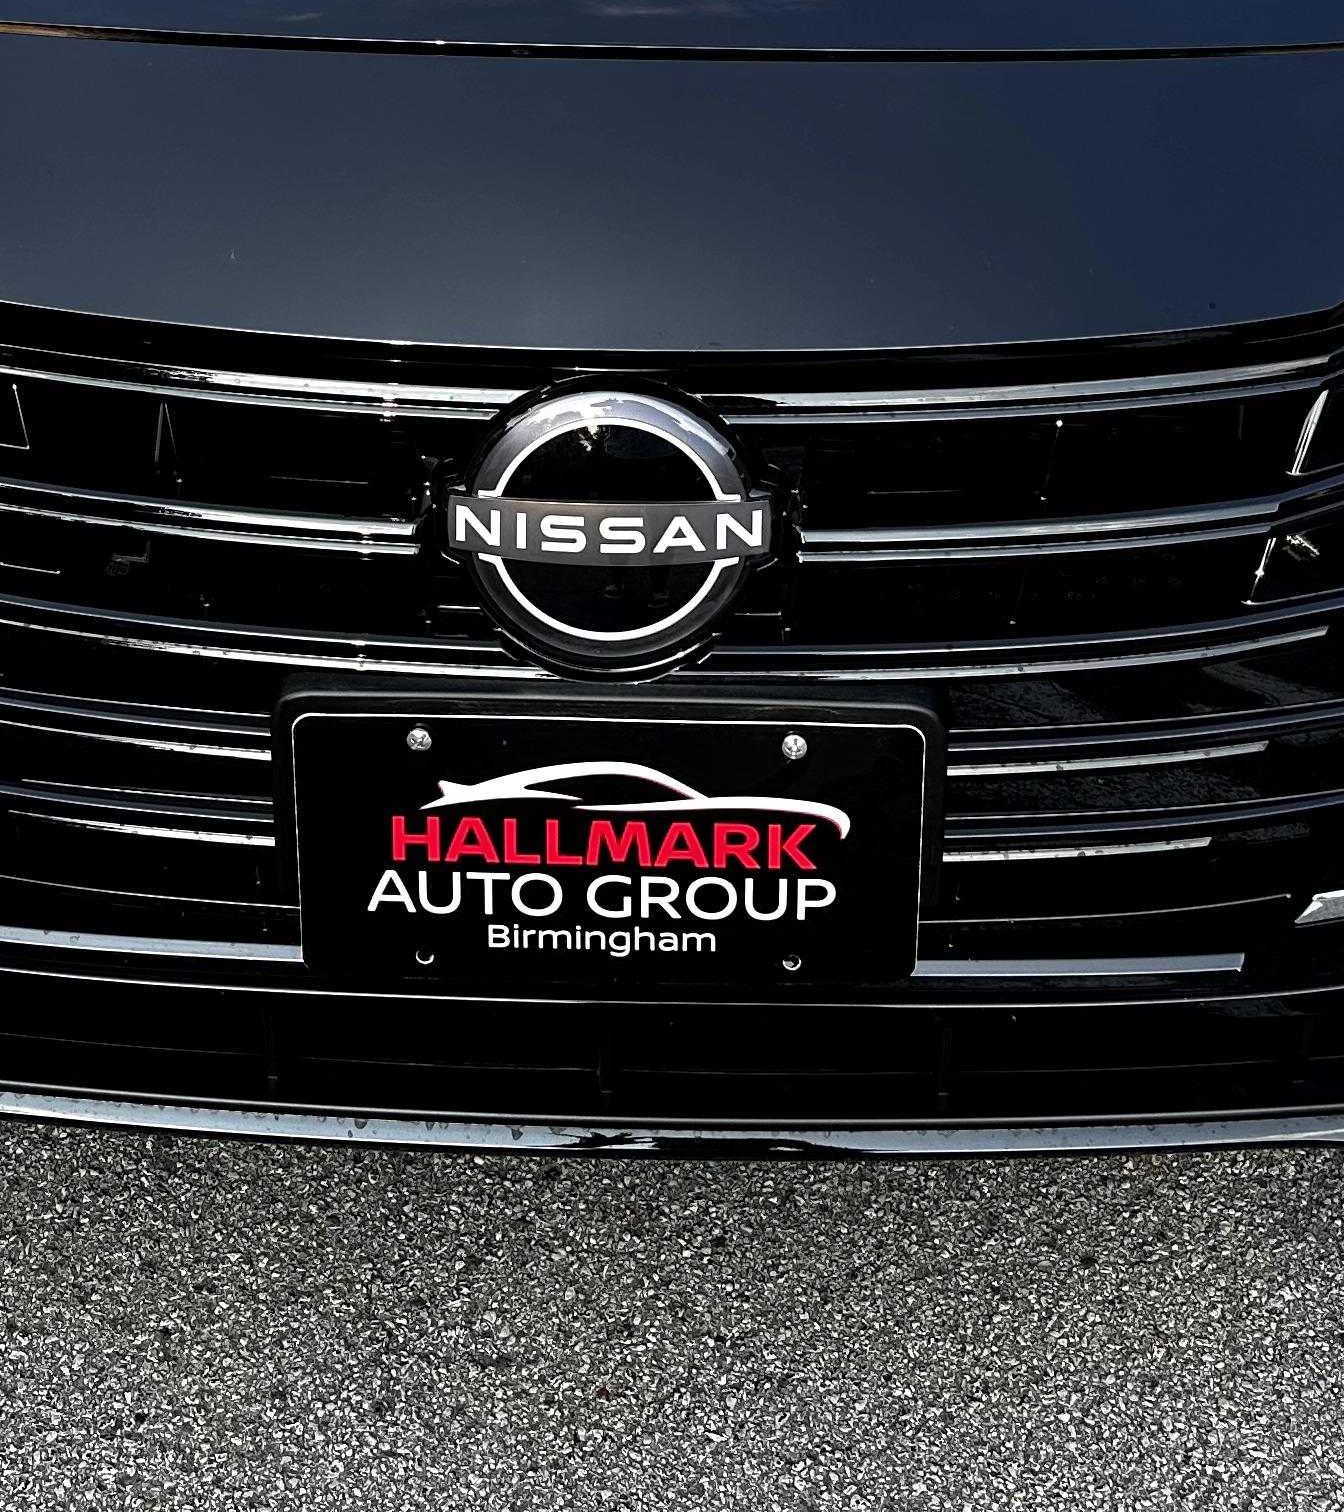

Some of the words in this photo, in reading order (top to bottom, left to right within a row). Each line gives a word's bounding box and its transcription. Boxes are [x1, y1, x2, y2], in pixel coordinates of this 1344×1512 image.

[456, 501, 762, 553] NISSAN
[392, 816, 816, 869] HALLMARK
[368, 870, 562, 916] AUTO
[587, 875, 836, 920] GROUP
[488, 925, 715, 957] Birmingham
